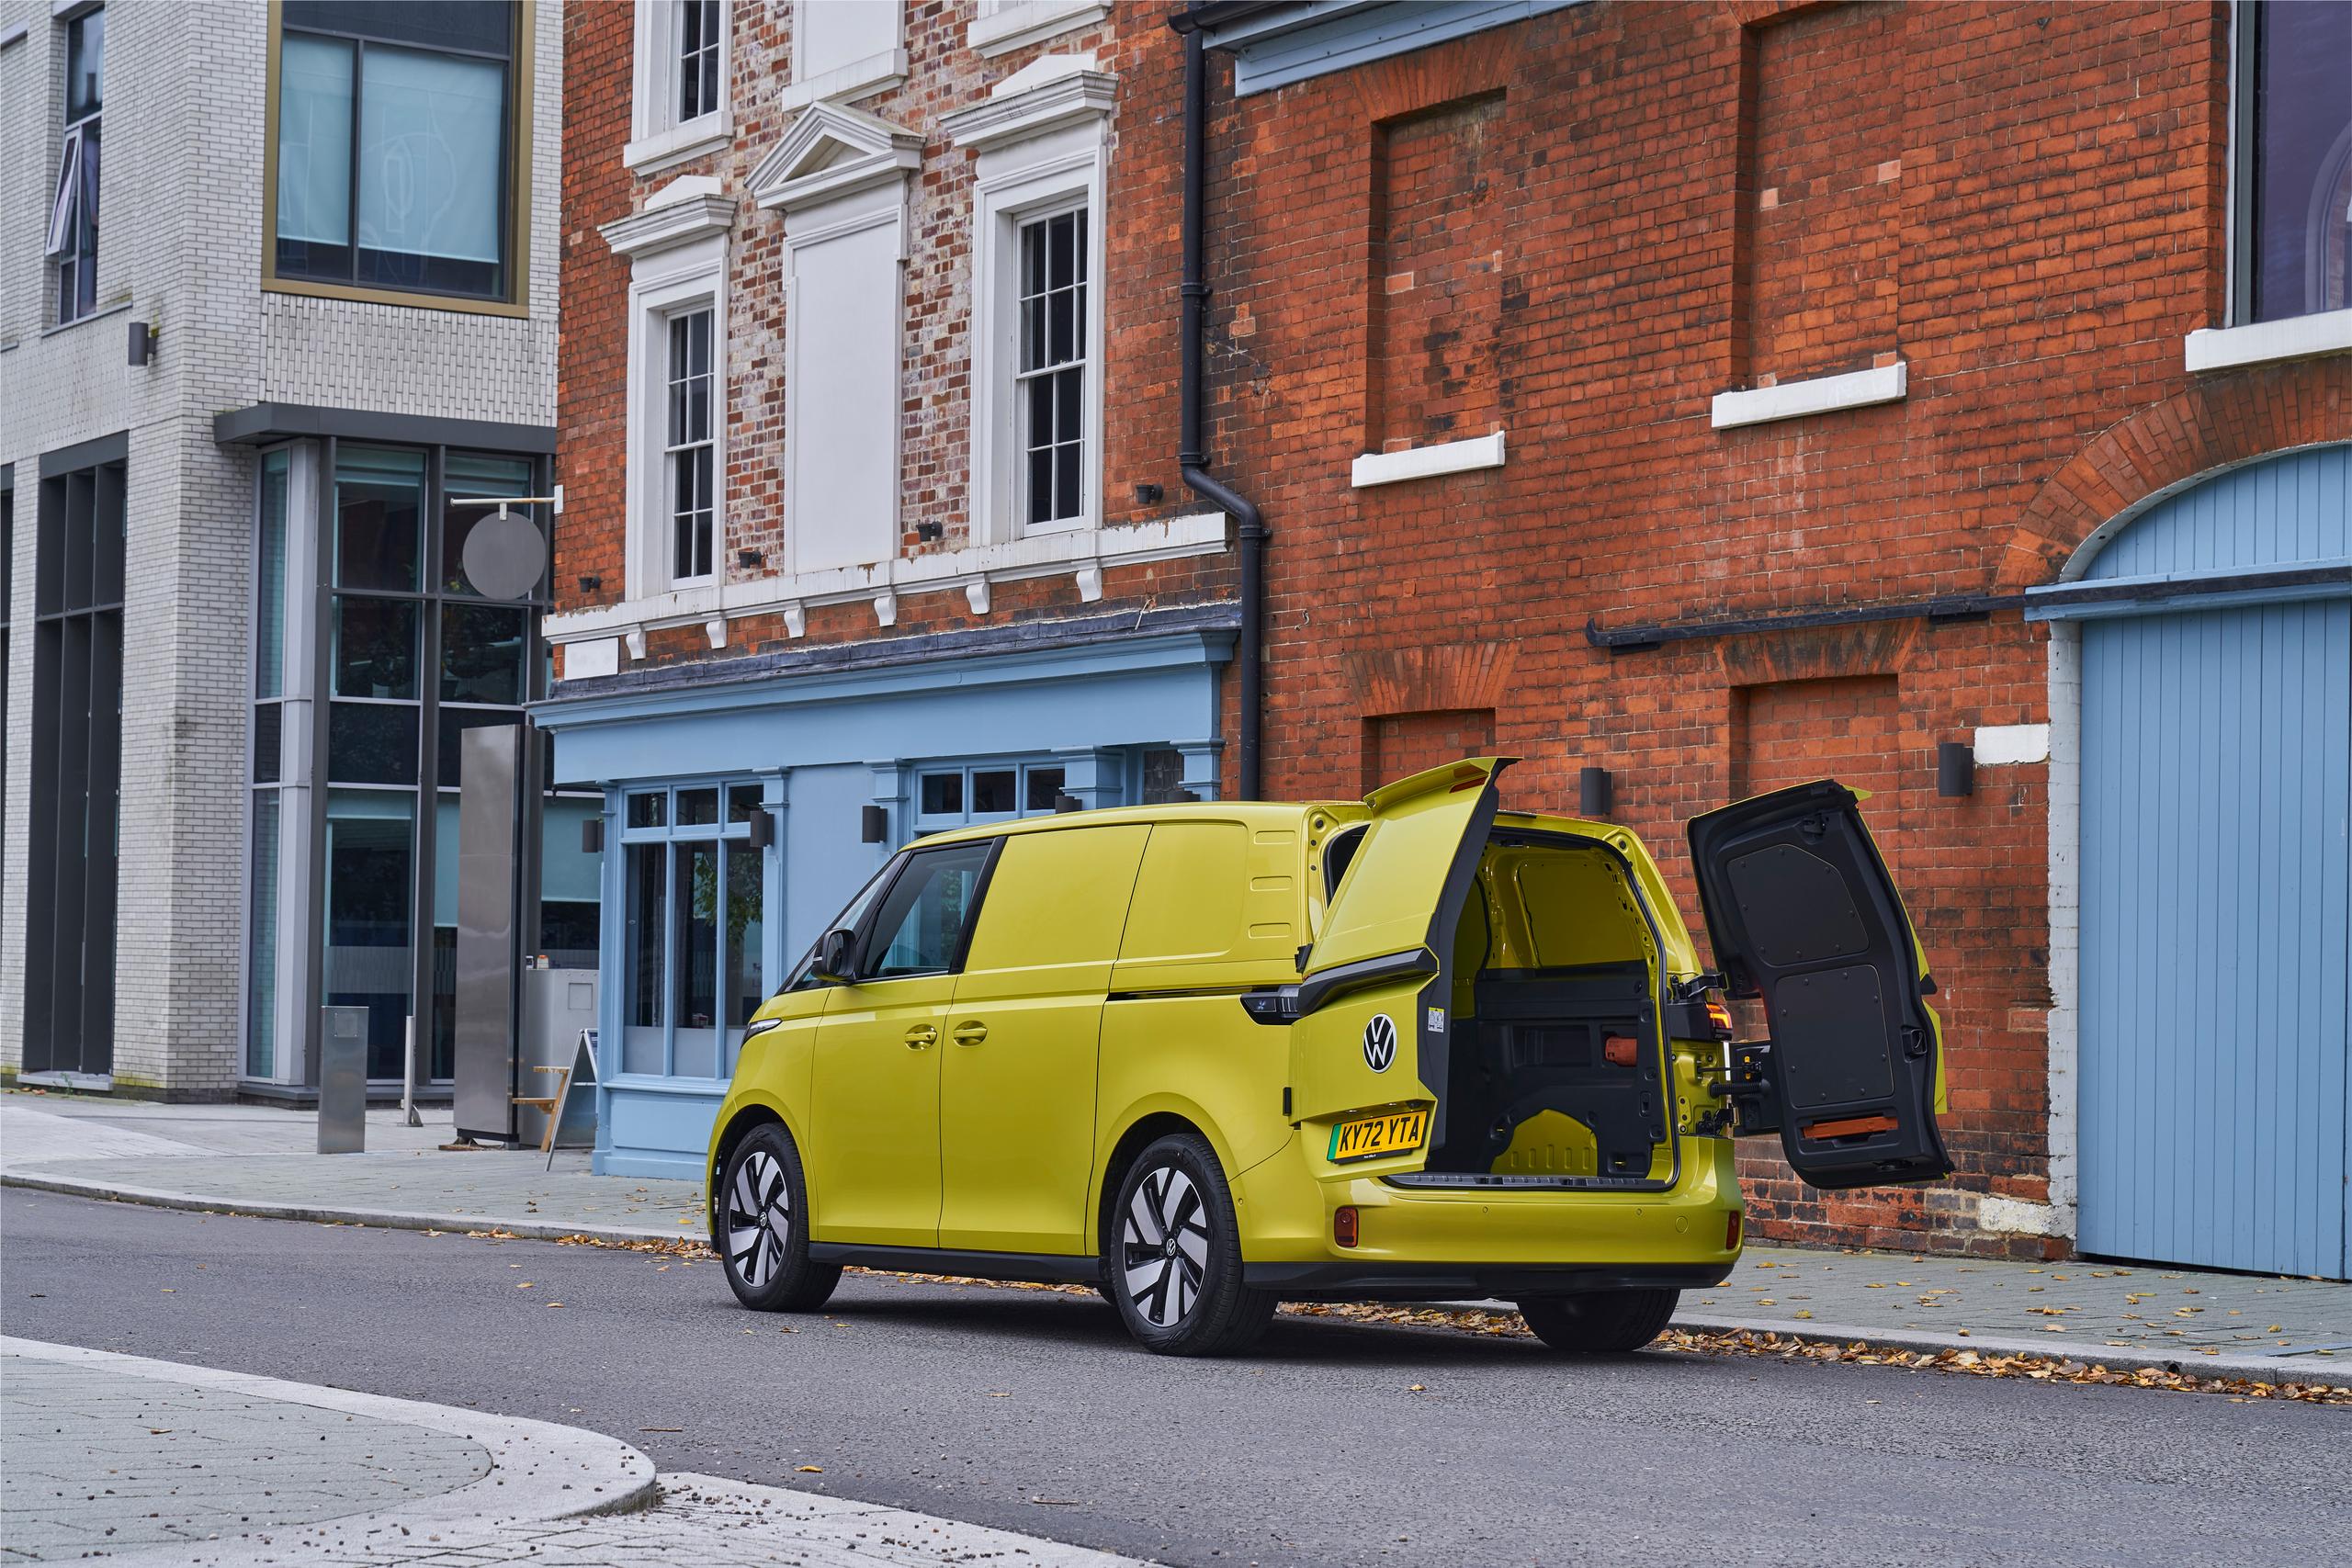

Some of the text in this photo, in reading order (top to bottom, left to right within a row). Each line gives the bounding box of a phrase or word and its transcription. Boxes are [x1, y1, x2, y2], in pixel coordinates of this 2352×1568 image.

[1363, 1014, 1396, 1072] VW
[1339, 1115, 1419, 1152] KY72 YTA
